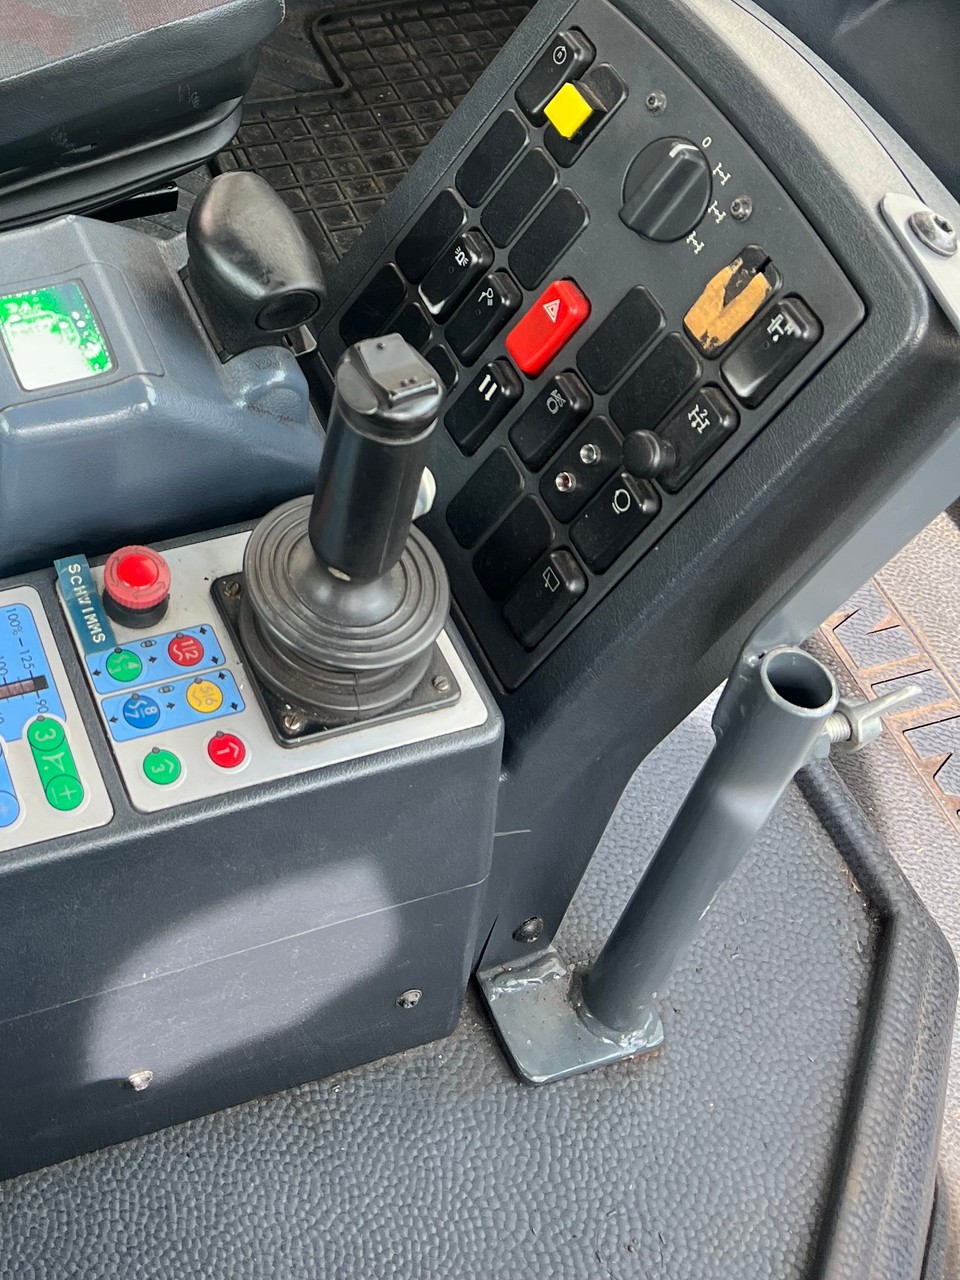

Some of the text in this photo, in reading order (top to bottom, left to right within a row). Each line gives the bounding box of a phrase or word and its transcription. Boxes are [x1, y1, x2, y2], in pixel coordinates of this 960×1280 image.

[68, 563, 106, 644] SCHWIMMS
[5, 607, 20, 636] 100%
[19, 649, 35, 670] 125
[34, 699, 50, 713] 90
[35, 728, 57, 742] 3
